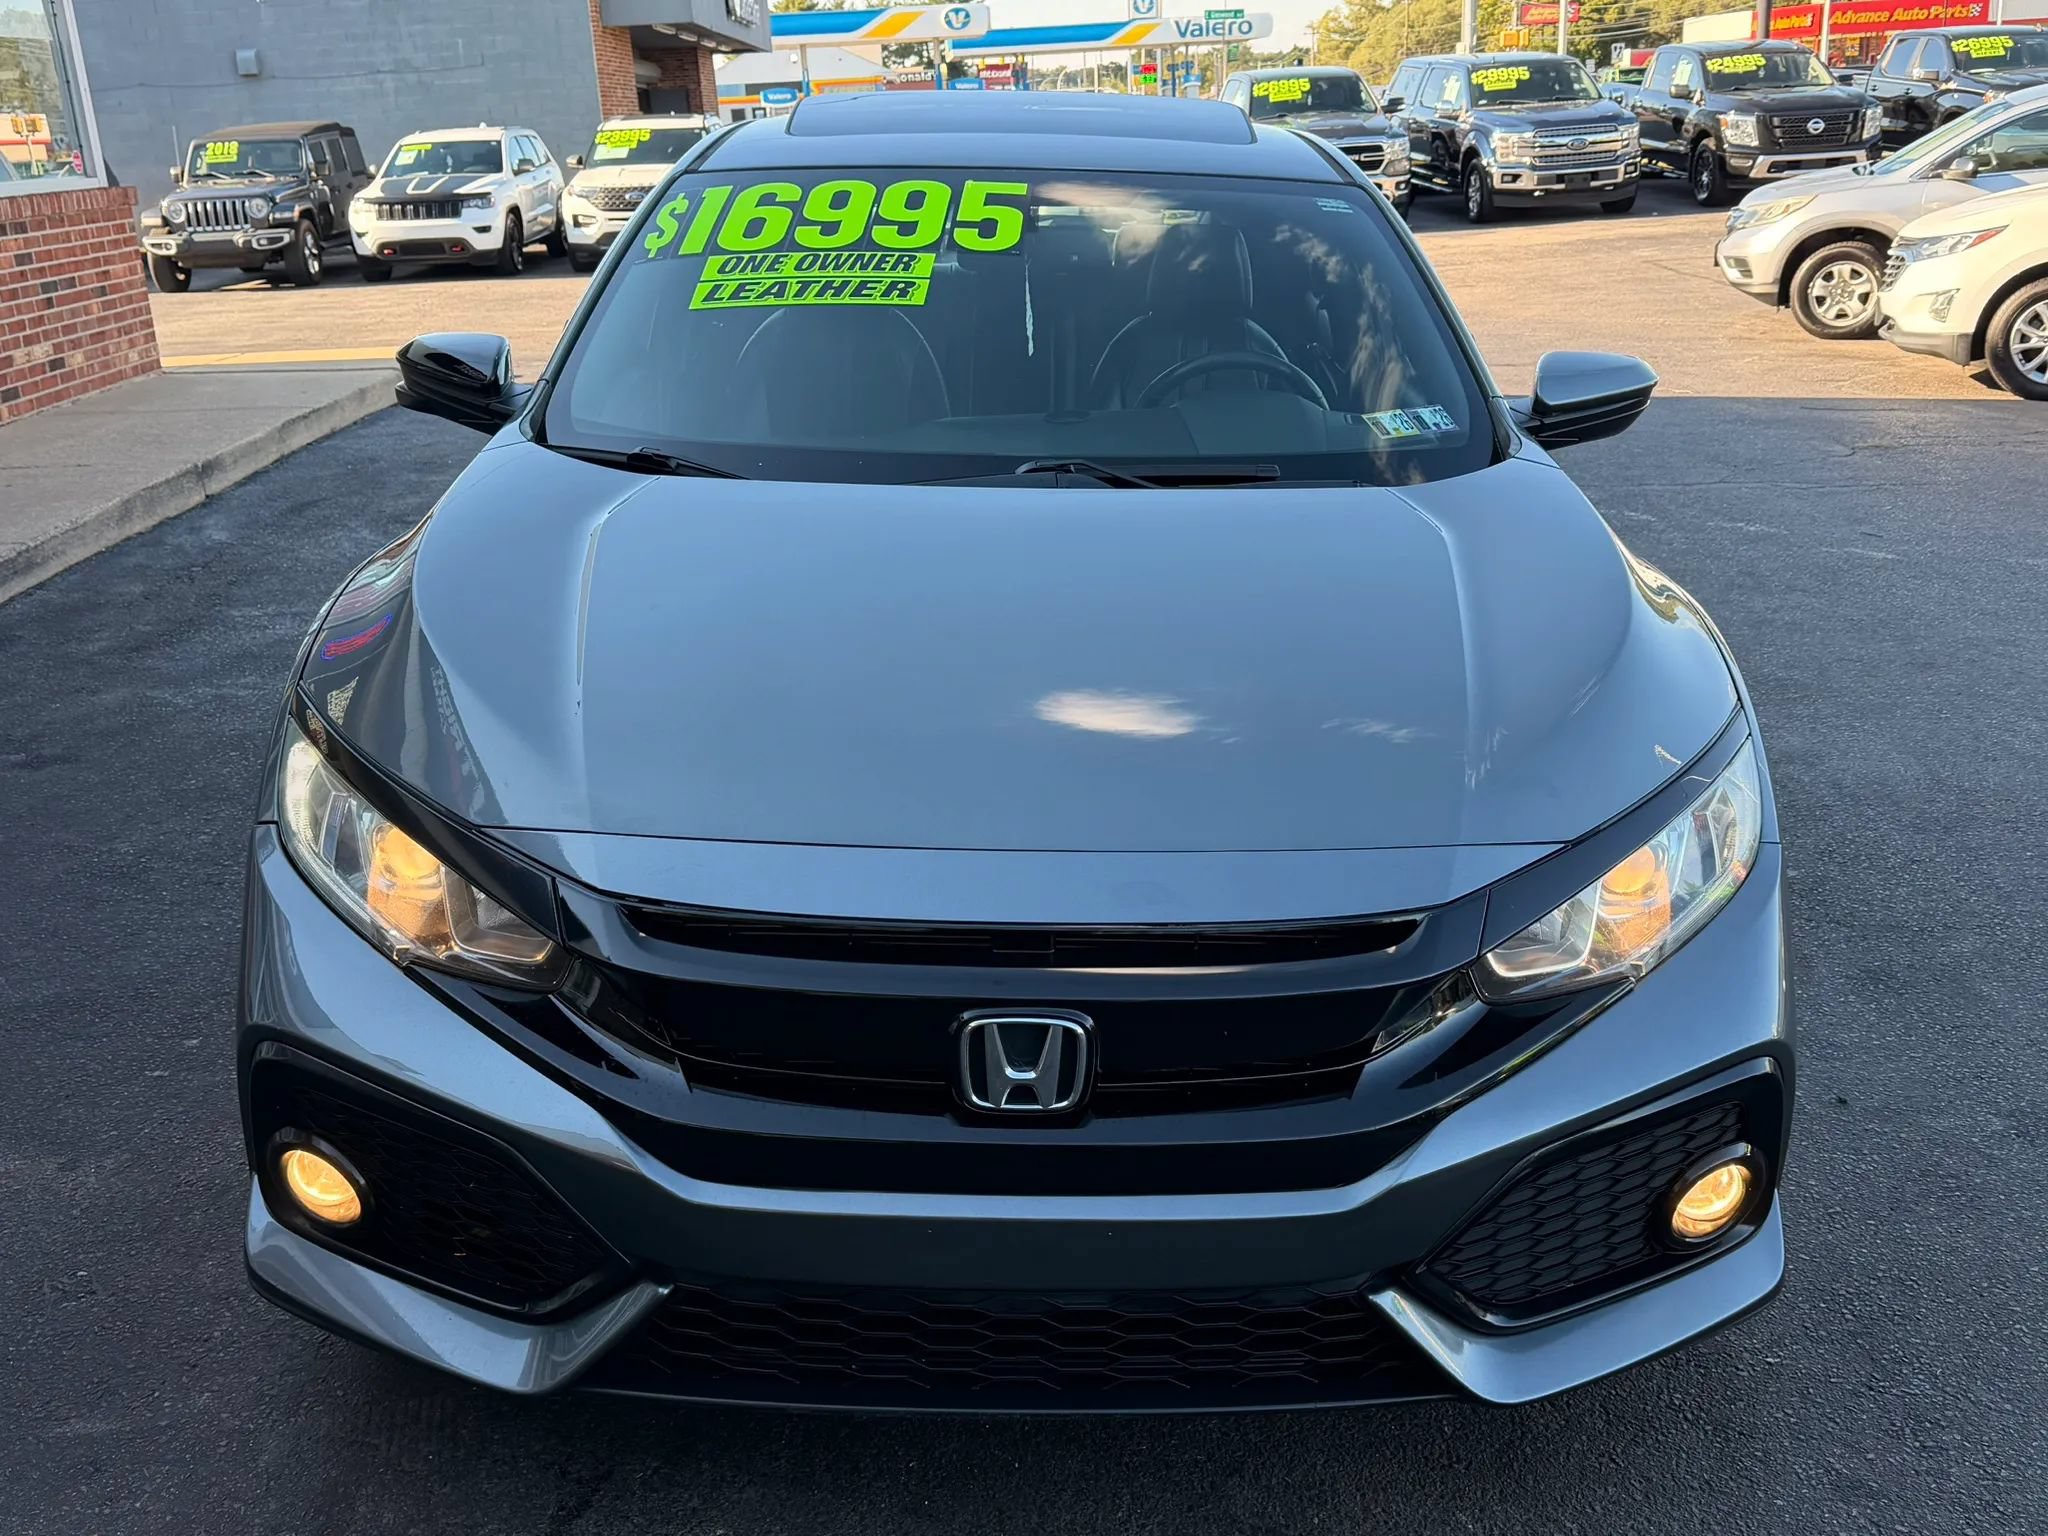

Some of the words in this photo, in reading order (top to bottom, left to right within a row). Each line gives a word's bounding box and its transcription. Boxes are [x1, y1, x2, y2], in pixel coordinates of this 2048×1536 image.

[1829, 12, 1889, 25] Advance
[1892, 7, 1928, 21] Auto
[1929, 4, 1970, 19] Parts
[1174, 20, 1253, 38] Valero
[1951, 36, 2014, 52] $26995
[1252, 78, 1311, 97] $26995
[205, 141, 239, 155] 2018
[643, 179, 1029, 258] $16995
[716, 254, 792, 276] ONE
[794, 252, 921, 275] OWNER
[700, 279, 921, 304] LEATHER
